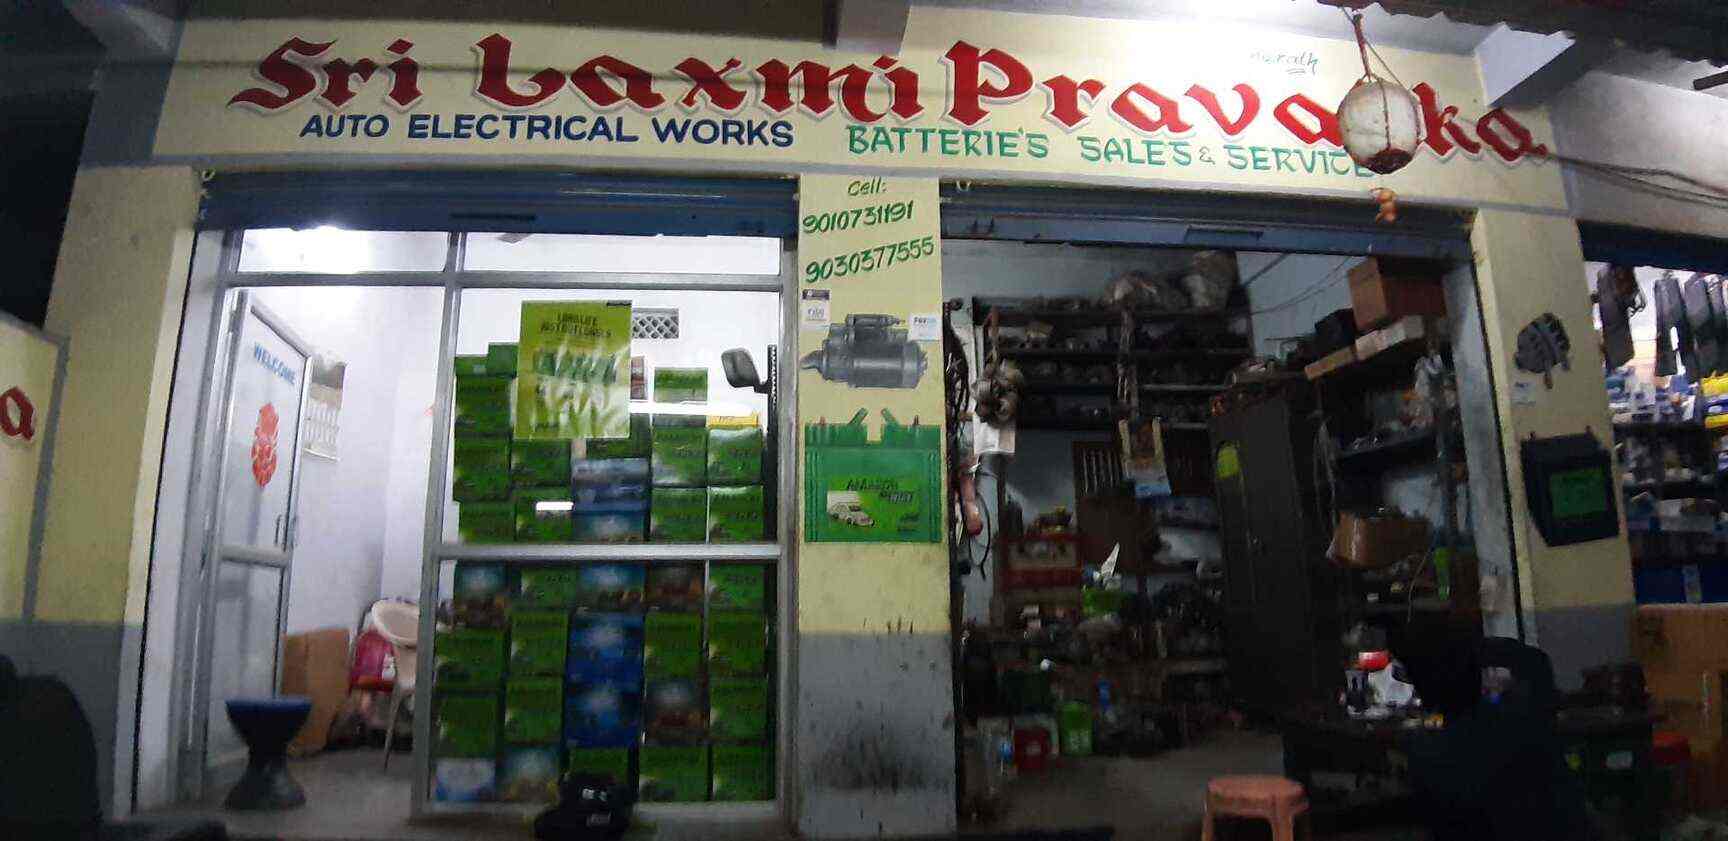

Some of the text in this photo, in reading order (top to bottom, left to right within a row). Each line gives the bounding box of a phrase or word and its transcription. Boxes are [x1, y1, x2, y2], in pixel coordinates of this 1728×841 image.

[228, 33, 1547, 162] Sri Laxmi Pravaka
[299, 114, 794, 148] AUTO ELECTRICAL WORKS
[1077, 136, 1192, 166] SALES
[1199, 147, 1215, 165] &
[802, 200, 914, 234] 9010731191
[805, 235, 934, 283] 9030377555
[254, 343, 295, 385] WELCOME
